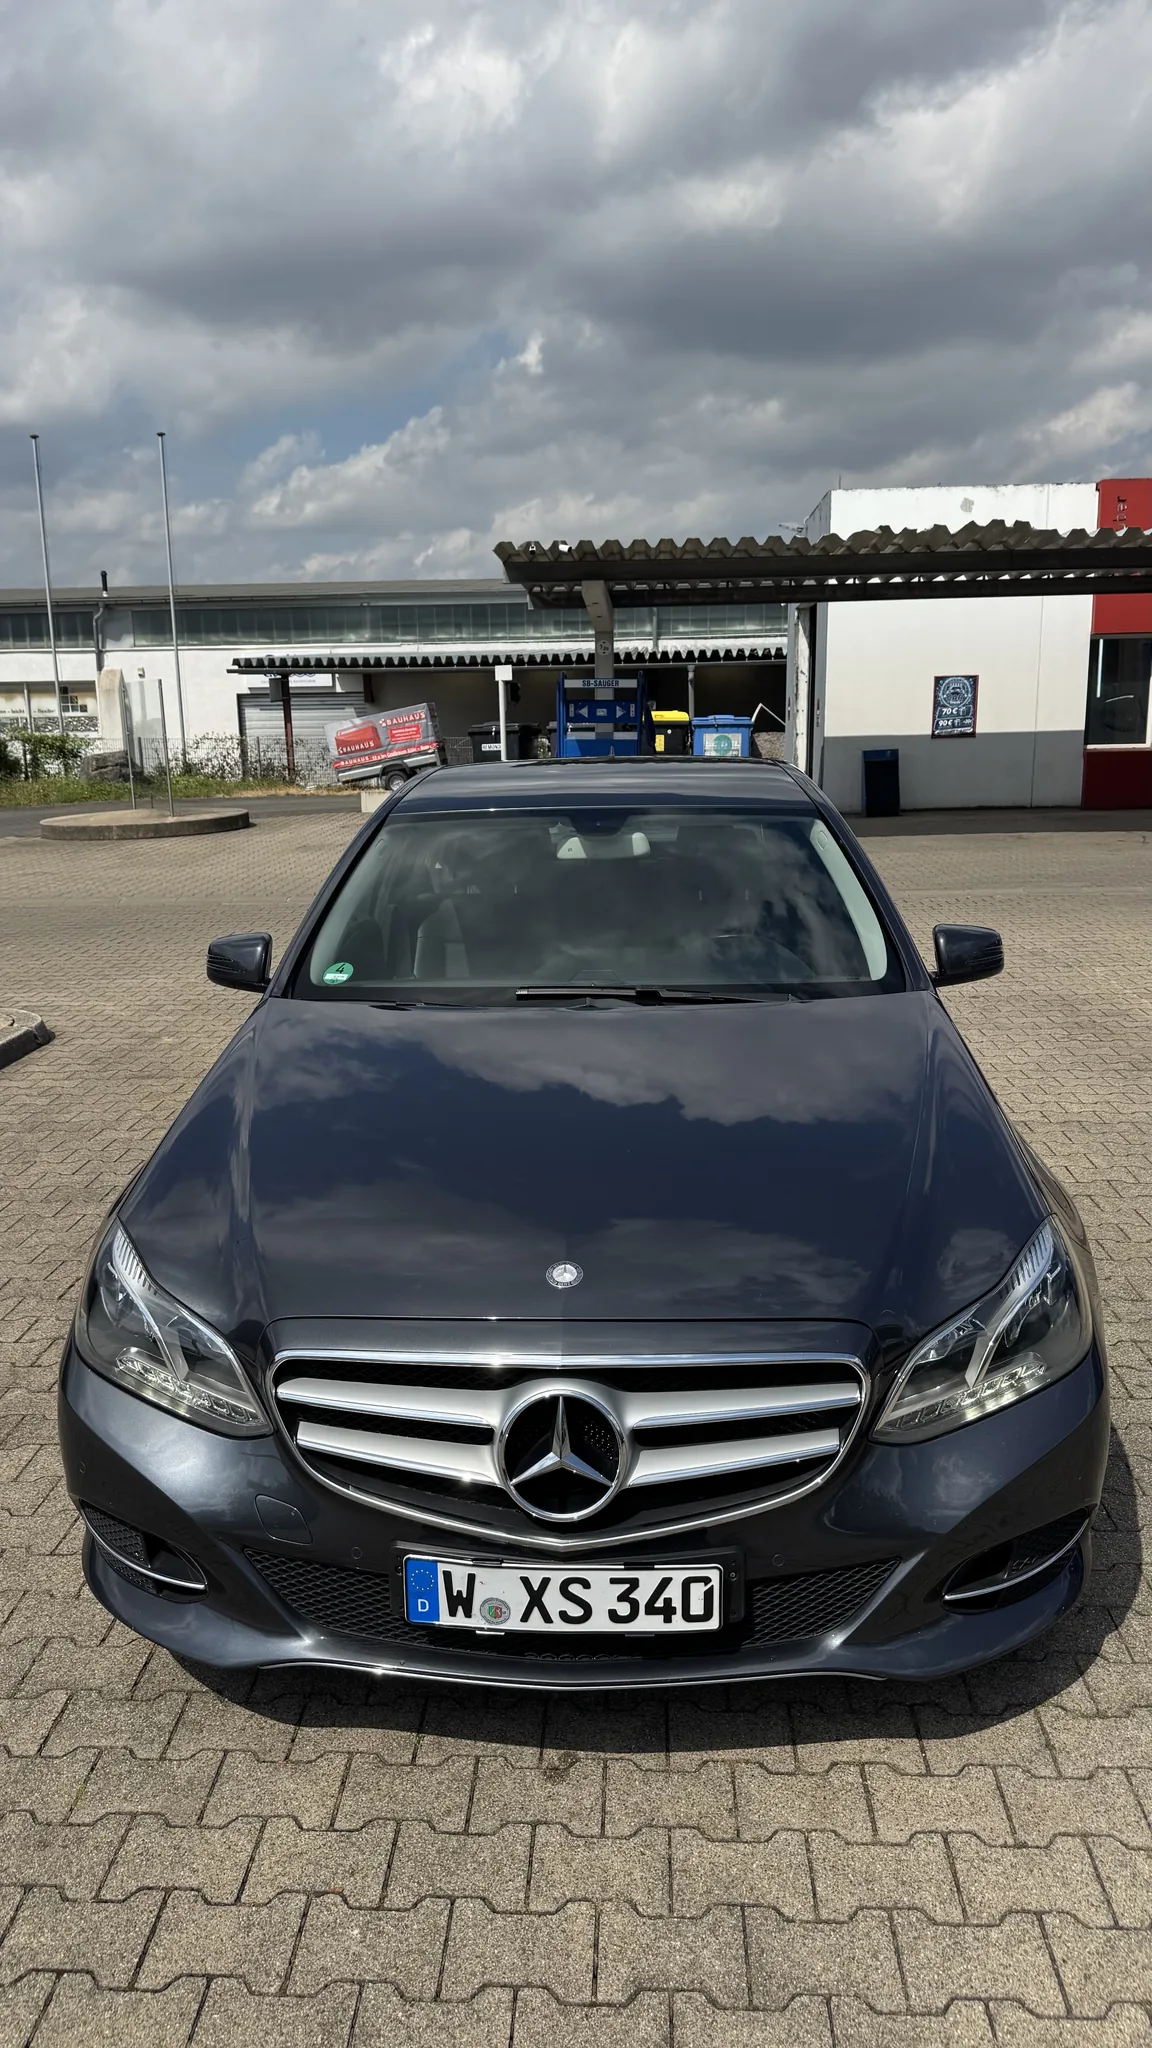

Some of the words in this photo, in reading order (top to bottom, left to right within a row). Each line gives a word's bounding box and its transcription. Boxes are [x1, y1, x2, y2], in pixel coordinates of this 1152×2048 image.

[386, 711, 426, 726] BAUHAUS
[343, 741, 375, 754] BAUHAUS
[340, 756, 369, 766] BAUHAUS
[336, 963, 345, 974] 4
[442, 1570, 477, 1619] W
[519, 1576, 593, 1625] XS
[608, 1576, 714, 1624] 340
[417, 1599, 429, 1613] D
